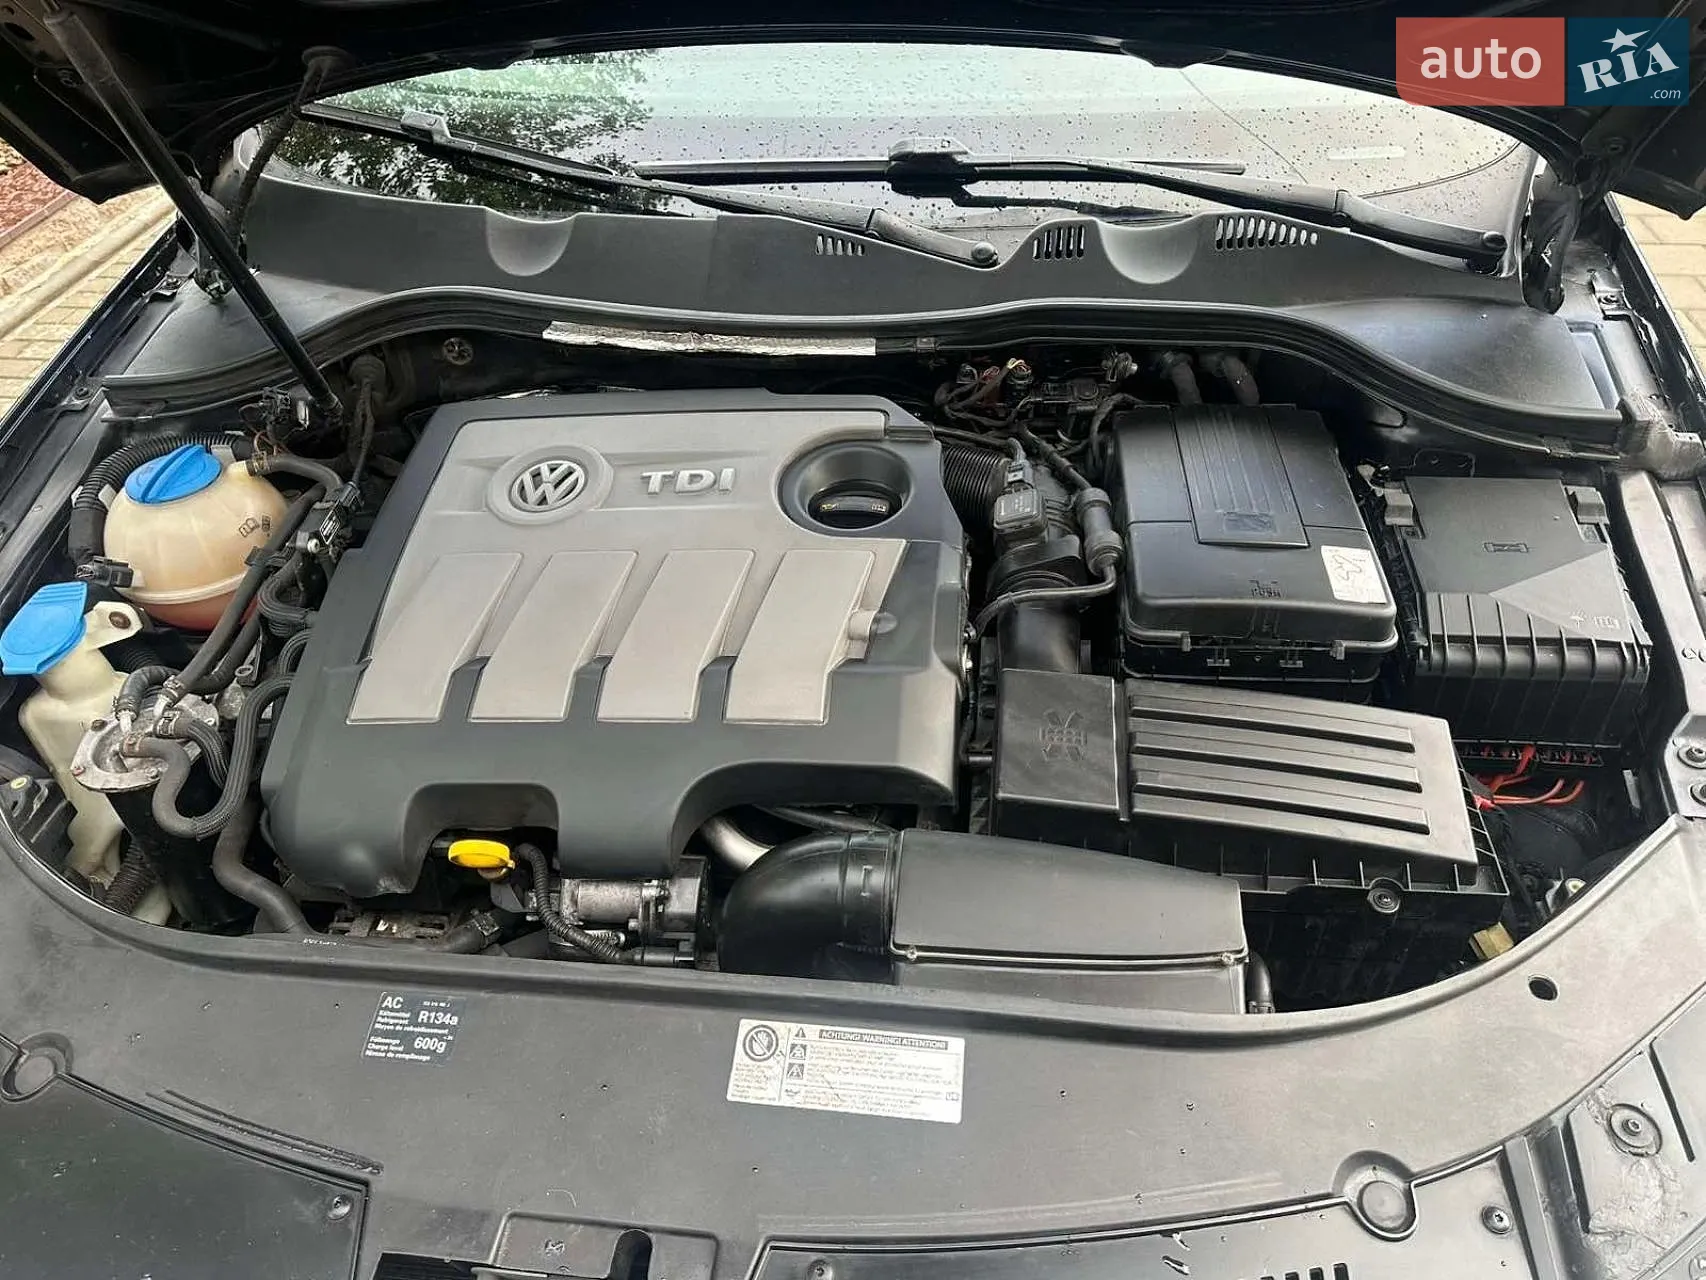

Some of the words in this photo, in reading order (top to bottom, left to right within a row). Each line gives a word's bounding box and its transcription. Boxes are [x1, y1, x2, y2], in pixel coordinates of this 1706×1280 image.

[512, 460, 586, 511] VW
[641, 467, 737, 495] TDI
[382, 996, 404, 1008] AC
[417, 1010, 459, 1025] R134a
[414, 1037, 447, 1053] 600g
